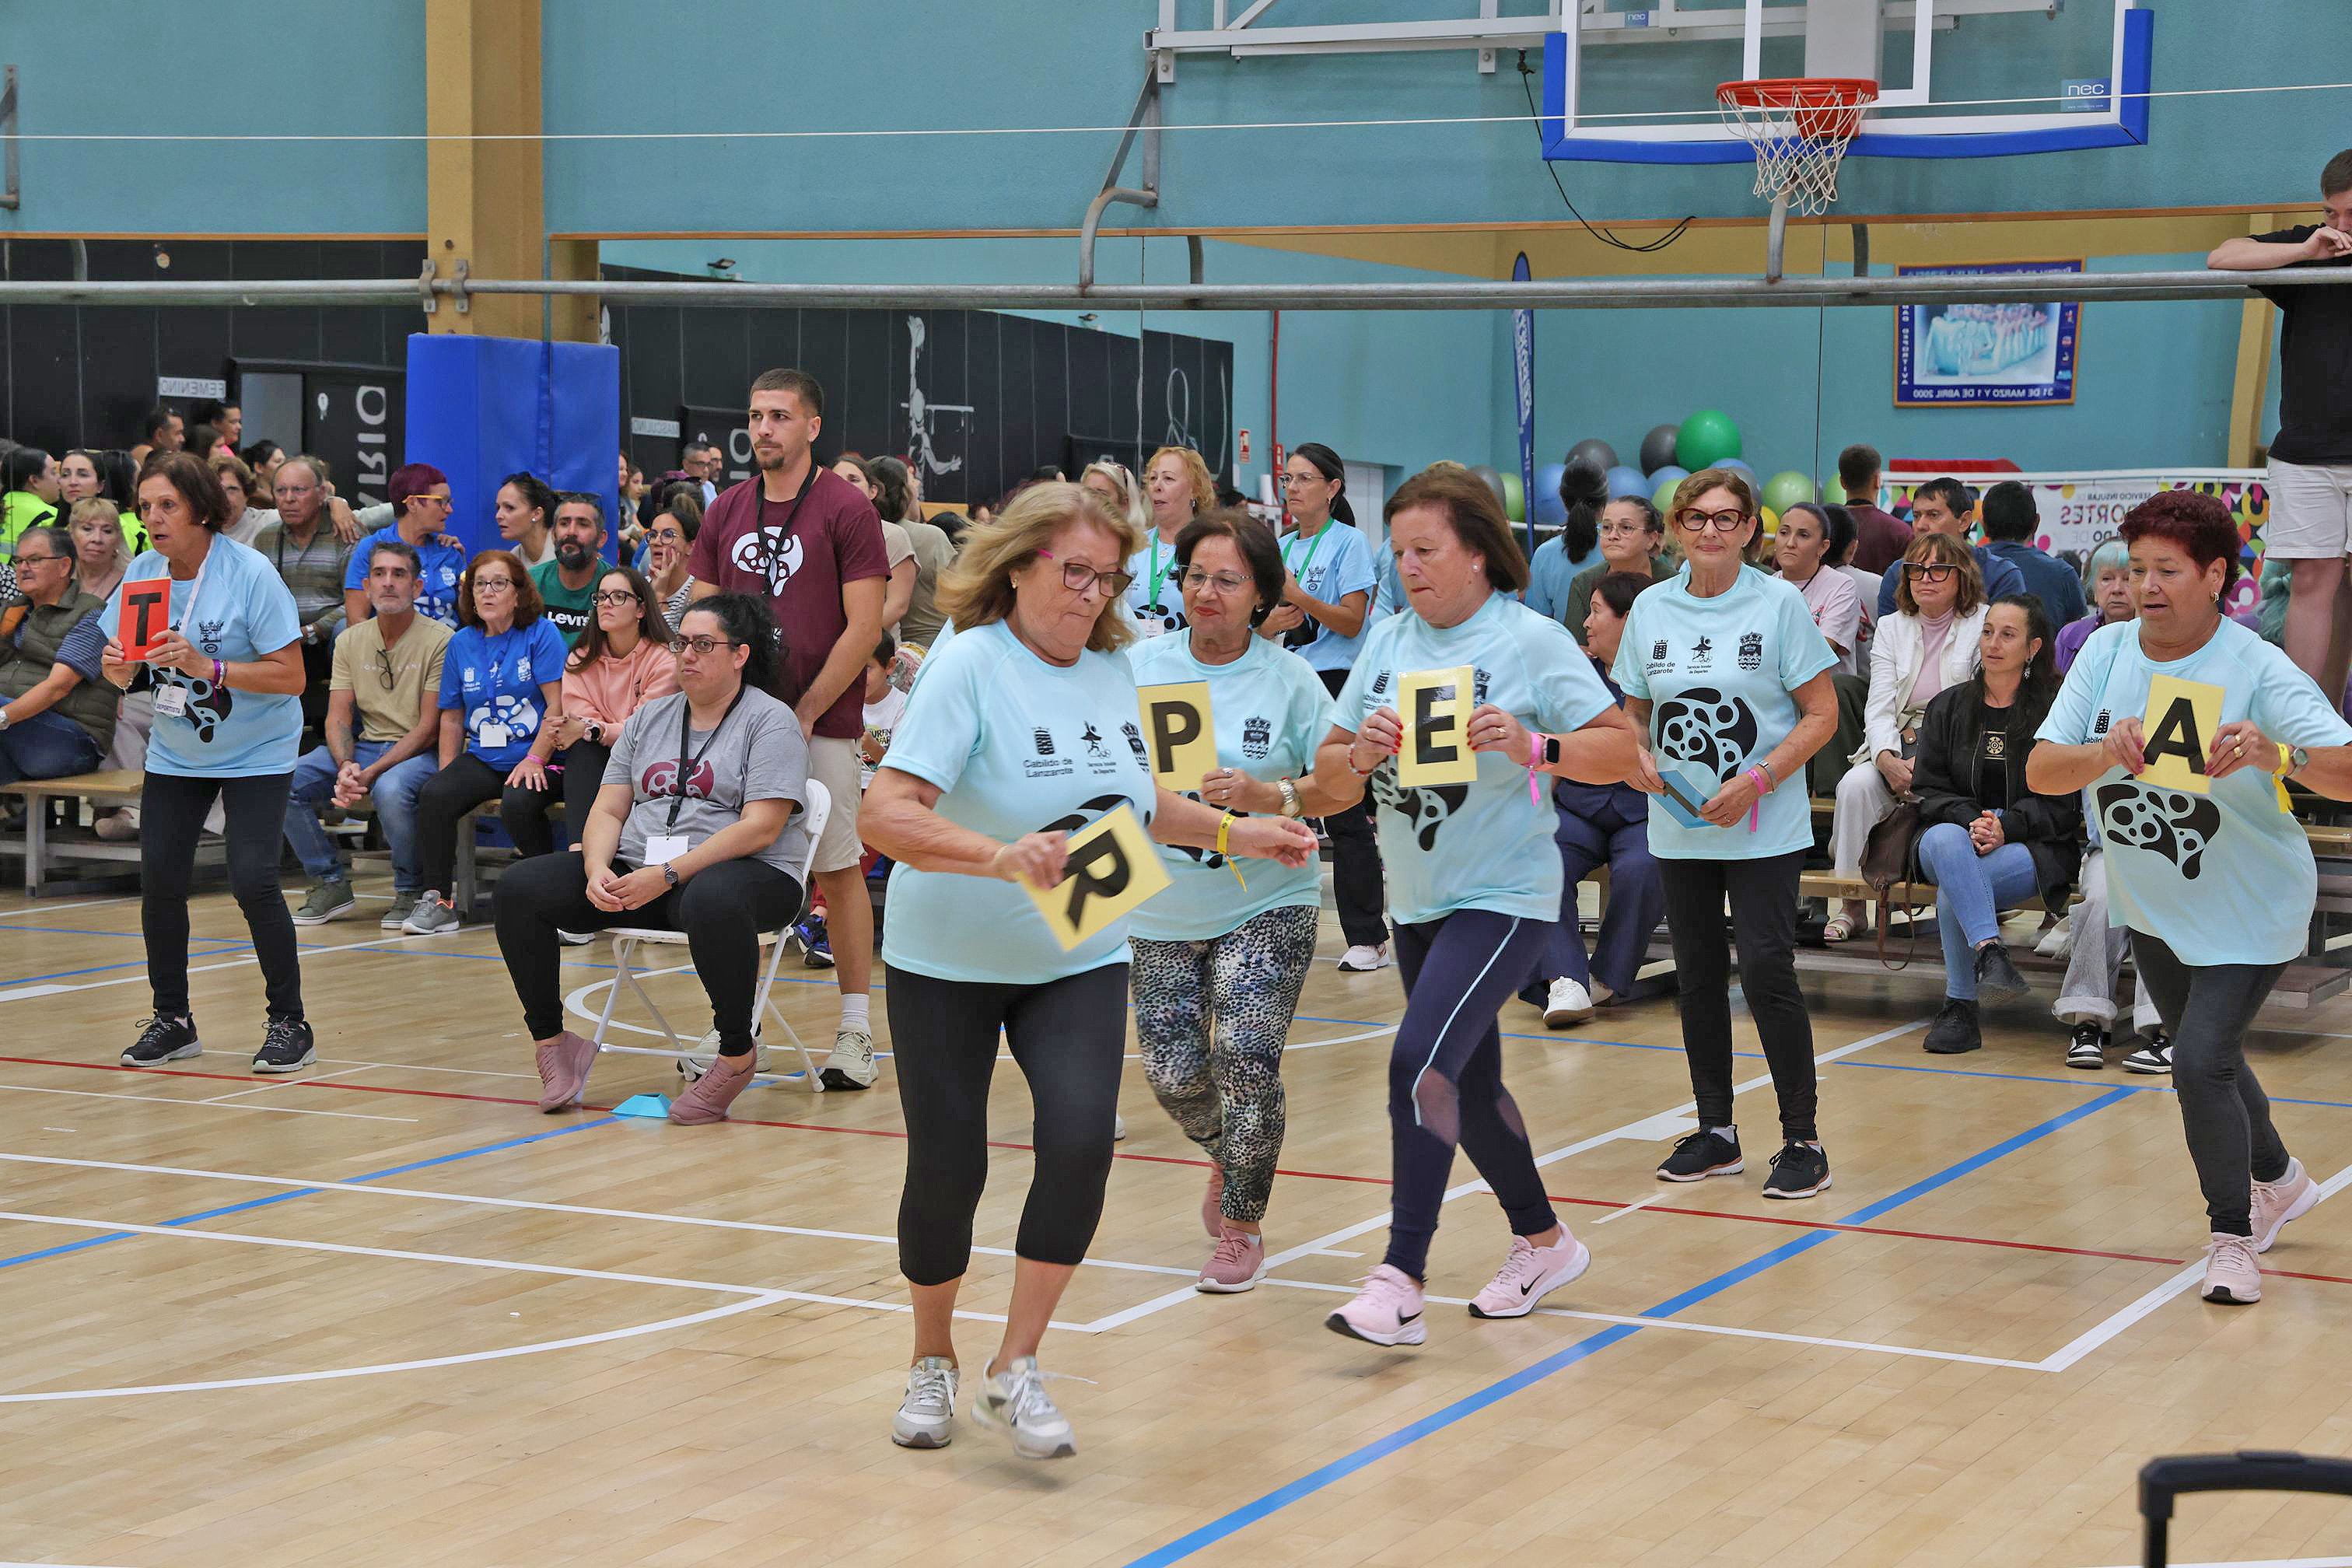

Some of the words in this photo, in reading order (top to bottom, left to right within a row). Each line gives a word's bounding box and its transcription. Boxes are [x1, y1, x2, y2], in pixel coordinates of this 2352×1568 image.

[2068, 84, 2104, 96] nec
[128, 592, 162, 646] T
[1150, 700, 1201, 773] P
[1415, 685, 1458, 765] E
[2143, 696, 2207, 775] A
[1050, 828, 1130, 931] R
